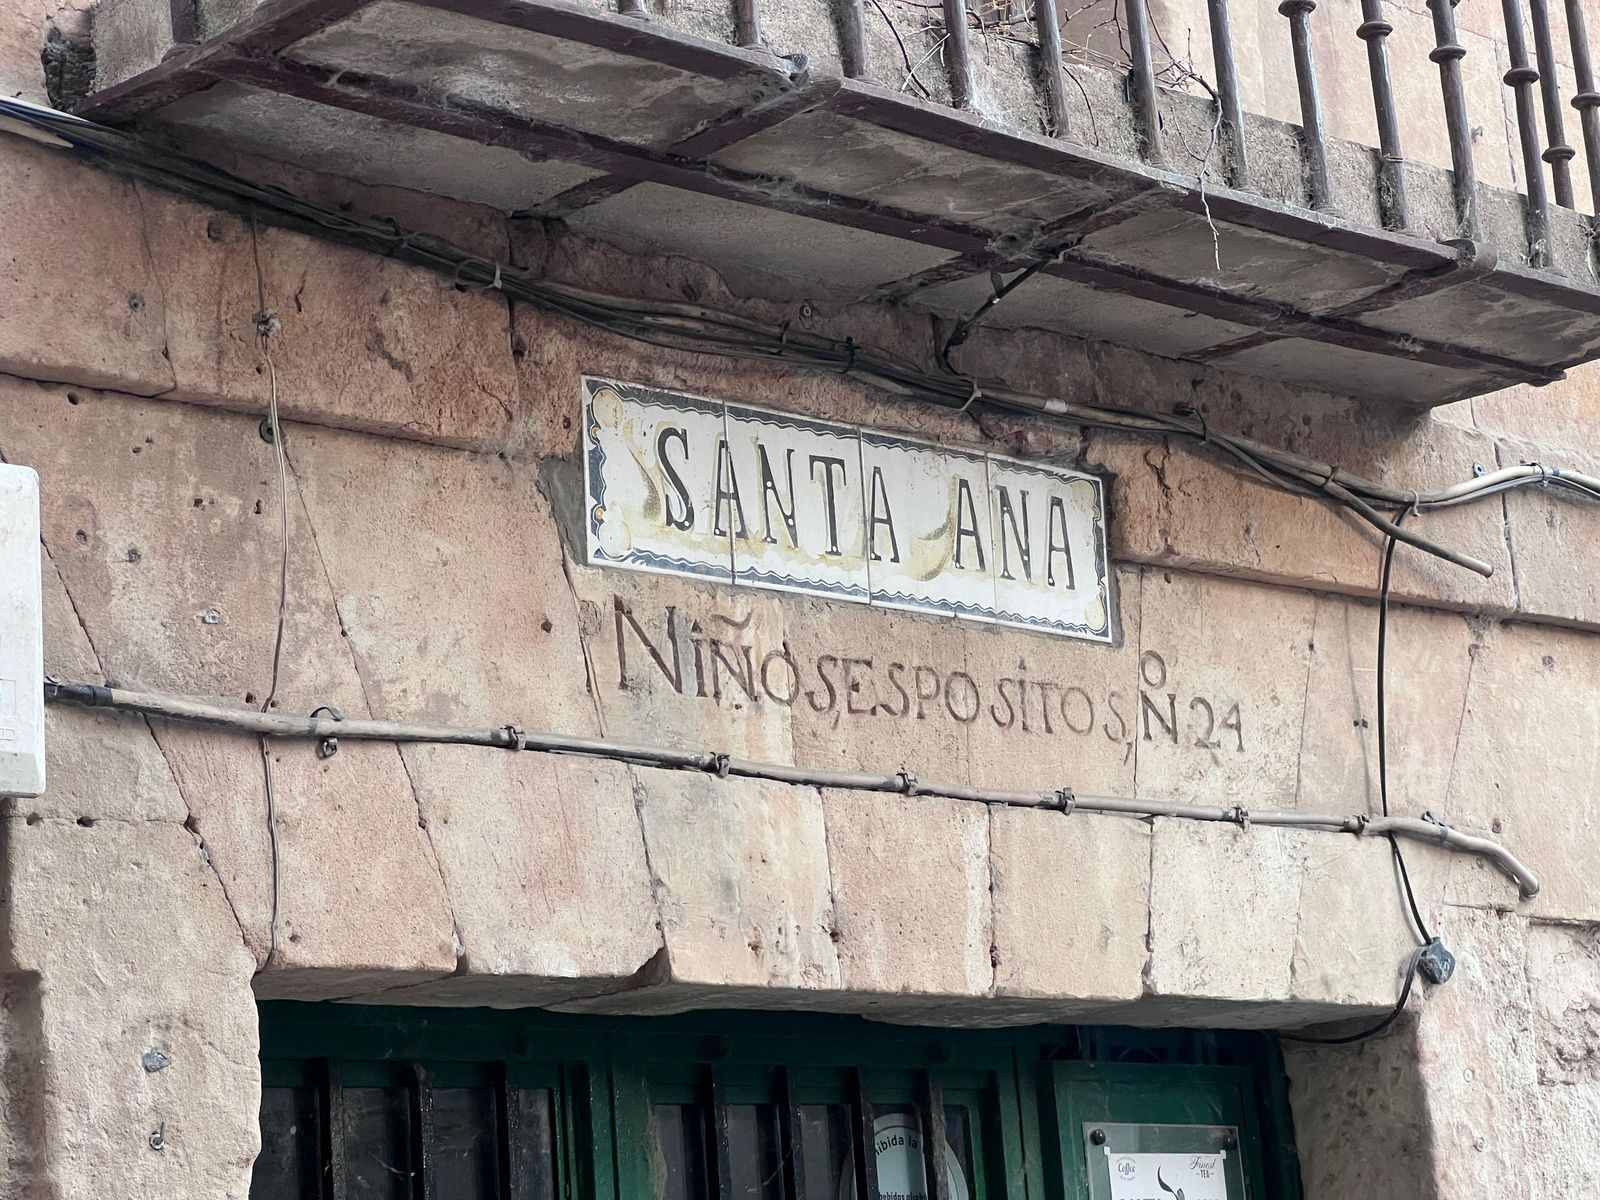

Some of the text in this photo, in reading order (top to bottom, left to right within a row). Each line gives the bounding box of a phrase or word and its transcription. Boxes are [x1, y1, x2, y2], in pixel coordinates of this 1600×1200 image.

[656, 427, 1077, 592] SANTA ANA
[1188, 696, 1245, 753] 24
[908, 1135, 918, 1149] la
[1117, 1162, 1136, 1176] Coffee
